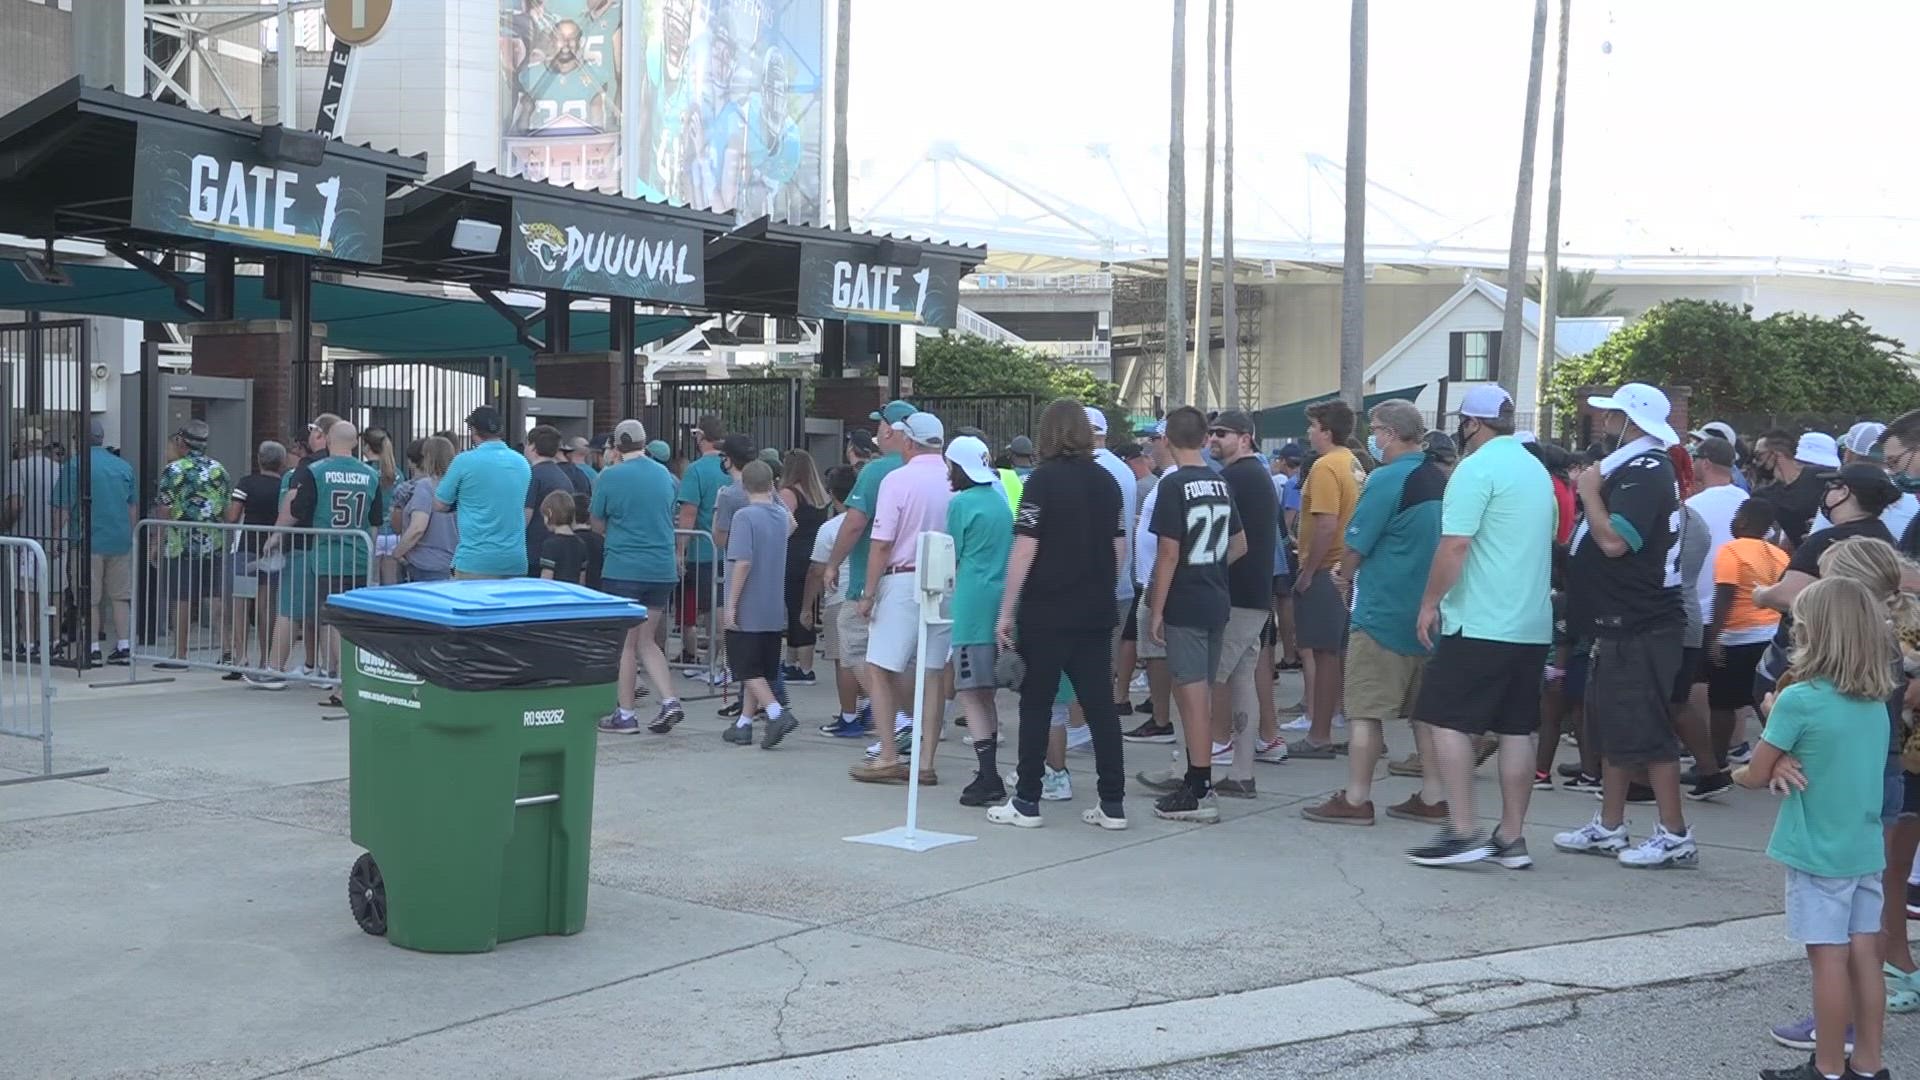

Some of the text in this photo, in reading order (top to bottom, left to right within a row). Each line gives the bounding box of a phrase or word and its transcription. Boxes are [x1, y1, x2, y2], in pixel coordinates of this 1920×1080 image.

[189, 154, 341, 249] GATE 1
[562, 225, 696, 286] DUUUVAL
[832, 261, 930, 317] GATE 1
[325, 471, 370, 485] POSLUSZNY
[330, 490, 366, 528] 51
[1186, 504, 1231, 565] 27
